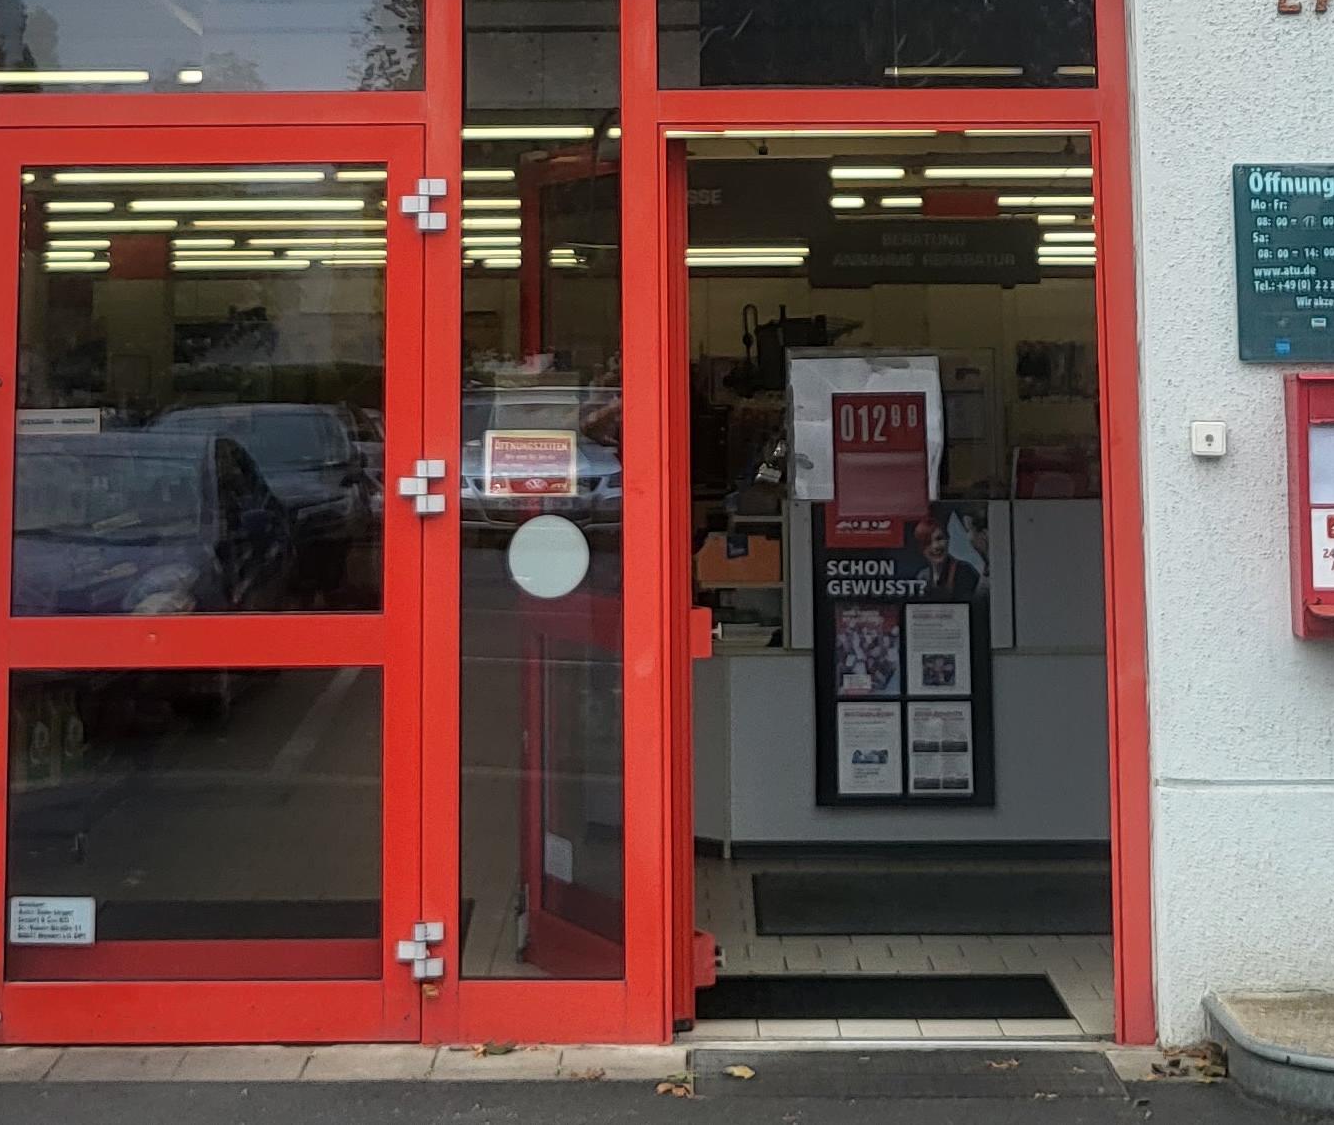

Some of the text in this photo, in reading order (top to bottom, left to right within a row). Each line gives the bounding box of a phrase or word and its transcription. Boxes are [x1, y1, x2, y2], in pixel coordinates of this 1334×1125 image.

[1252, 231, 1270, 243] Sa:
[1254, 264, 1316, 276] www.atu.de
[1296, 296, 1312, 307] Wir
[1323, 548, 1334, 558] 24
[827, 560, 894, 576] SCHON
[828, 579, 927, 596] GEWUSST?
